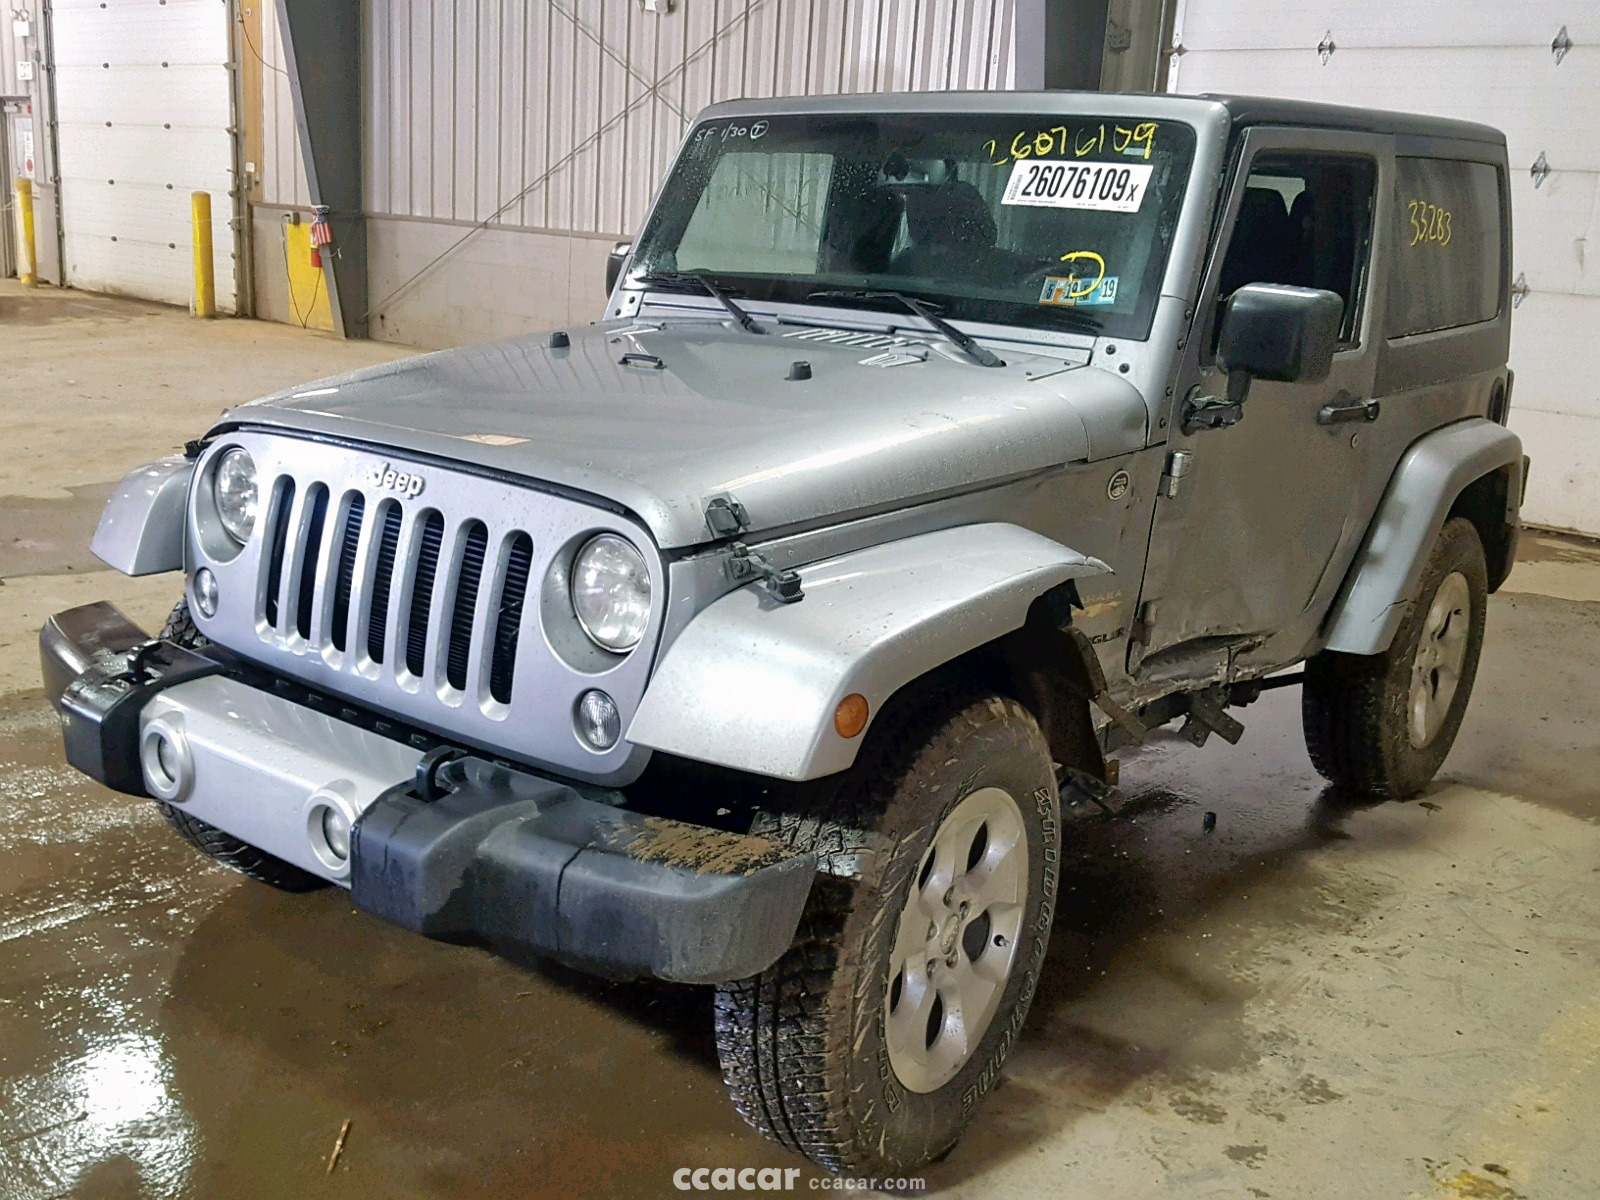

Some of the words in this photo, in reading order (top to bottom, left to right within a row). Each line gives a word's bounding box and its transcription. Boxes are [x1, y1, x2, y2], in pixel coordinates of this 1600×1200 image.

[720, 122, 747, 143] 1/30
[982, 122, 1159, 166] 26076109
[1045, 283, 1055, 300] 5
[1102, 280, 1115, 298] 19
[368, 462, 426, 500] Jeep
